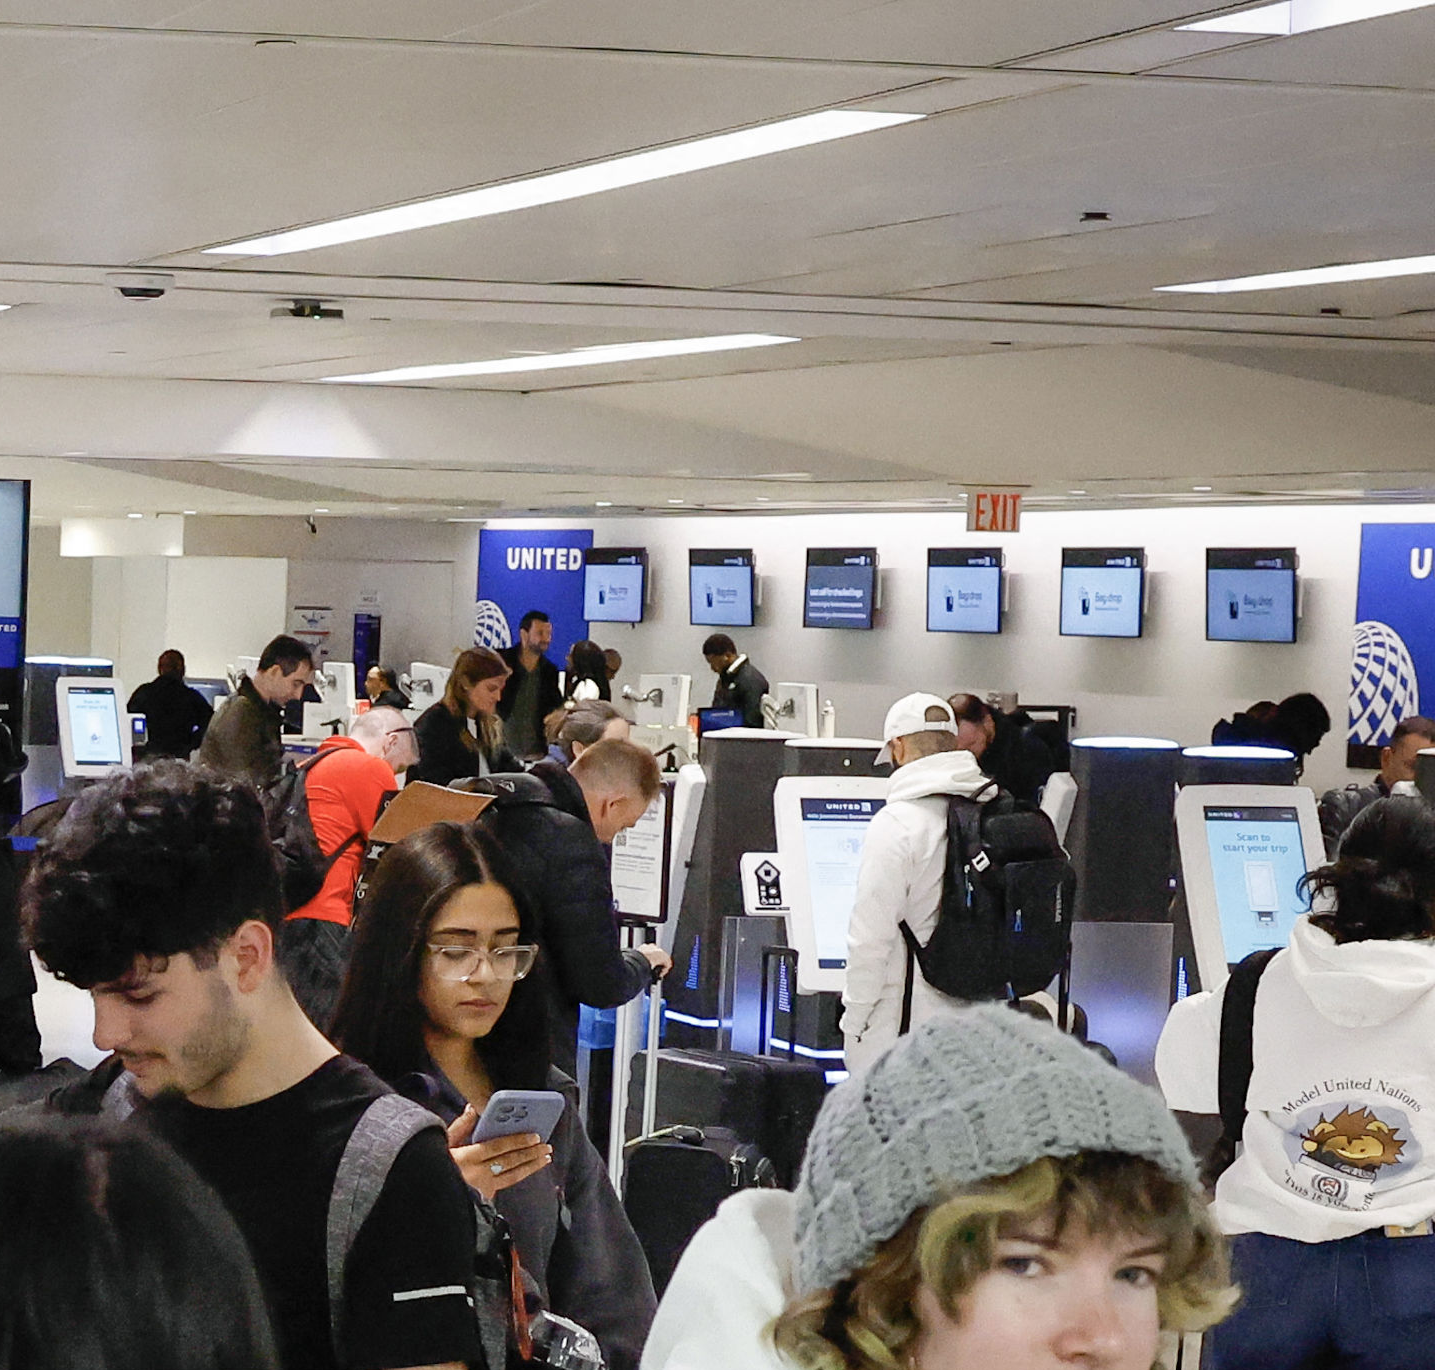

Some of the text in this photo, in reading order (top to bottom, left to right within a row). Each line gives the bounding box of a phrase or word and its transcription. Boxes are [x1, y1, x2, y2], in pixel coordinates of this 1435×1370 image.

[975, 493, 1022, 532] EXIT
[506, 547, 583, 572] UNITED
[825, 803, 861, 811] UNITED
[1236, 832, 1271, 842] Scan to
[1222, 843, 1289, 855] start your trip
[1281, 1077, 1423, 1116] Model United Nations
